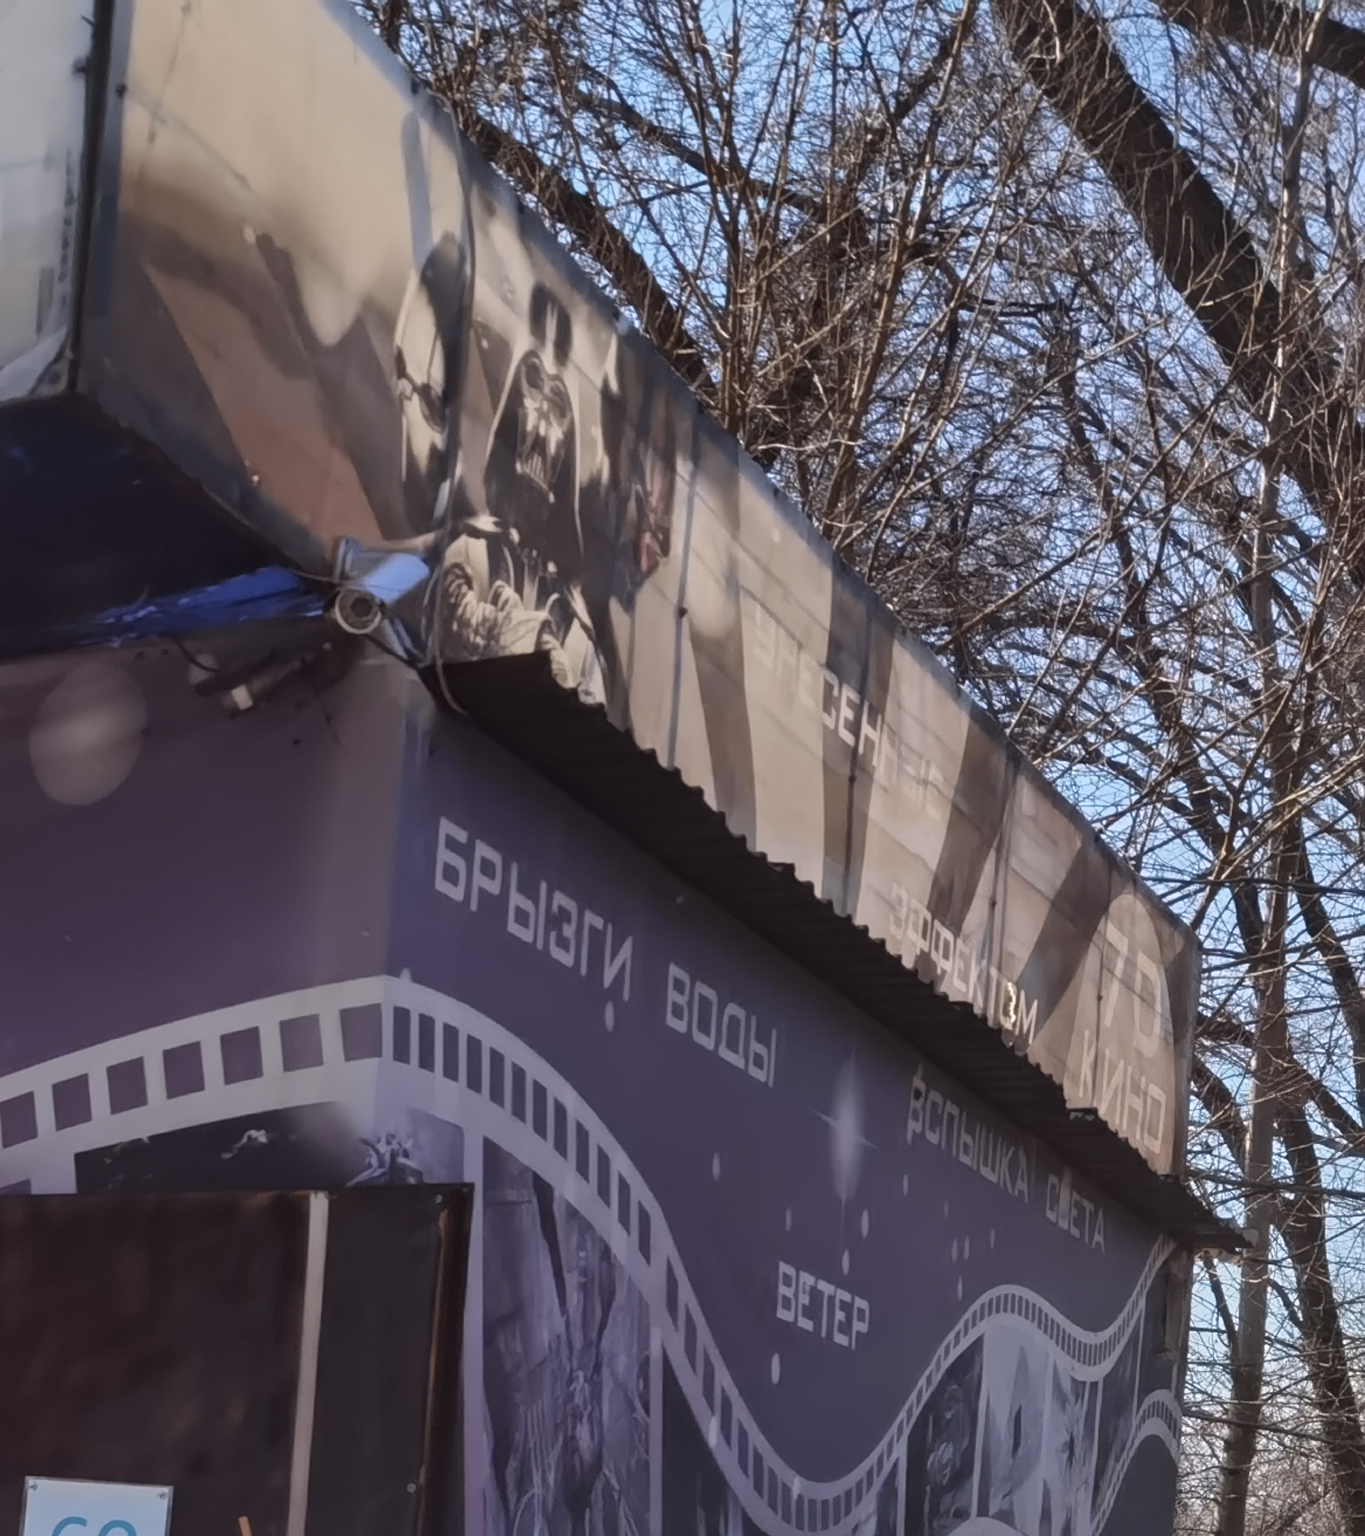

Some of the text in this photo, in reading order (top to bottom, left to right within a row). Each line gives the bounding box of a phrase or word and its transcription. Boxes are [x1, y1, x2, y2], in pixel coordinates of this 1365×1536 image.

[433, 815, 778, 1088] БРЫЗГИ ВОДЫ
[1077, 1028, 1167, 1156] КИНО
[775, 1260, 870, 1350] ВЕТЕР
